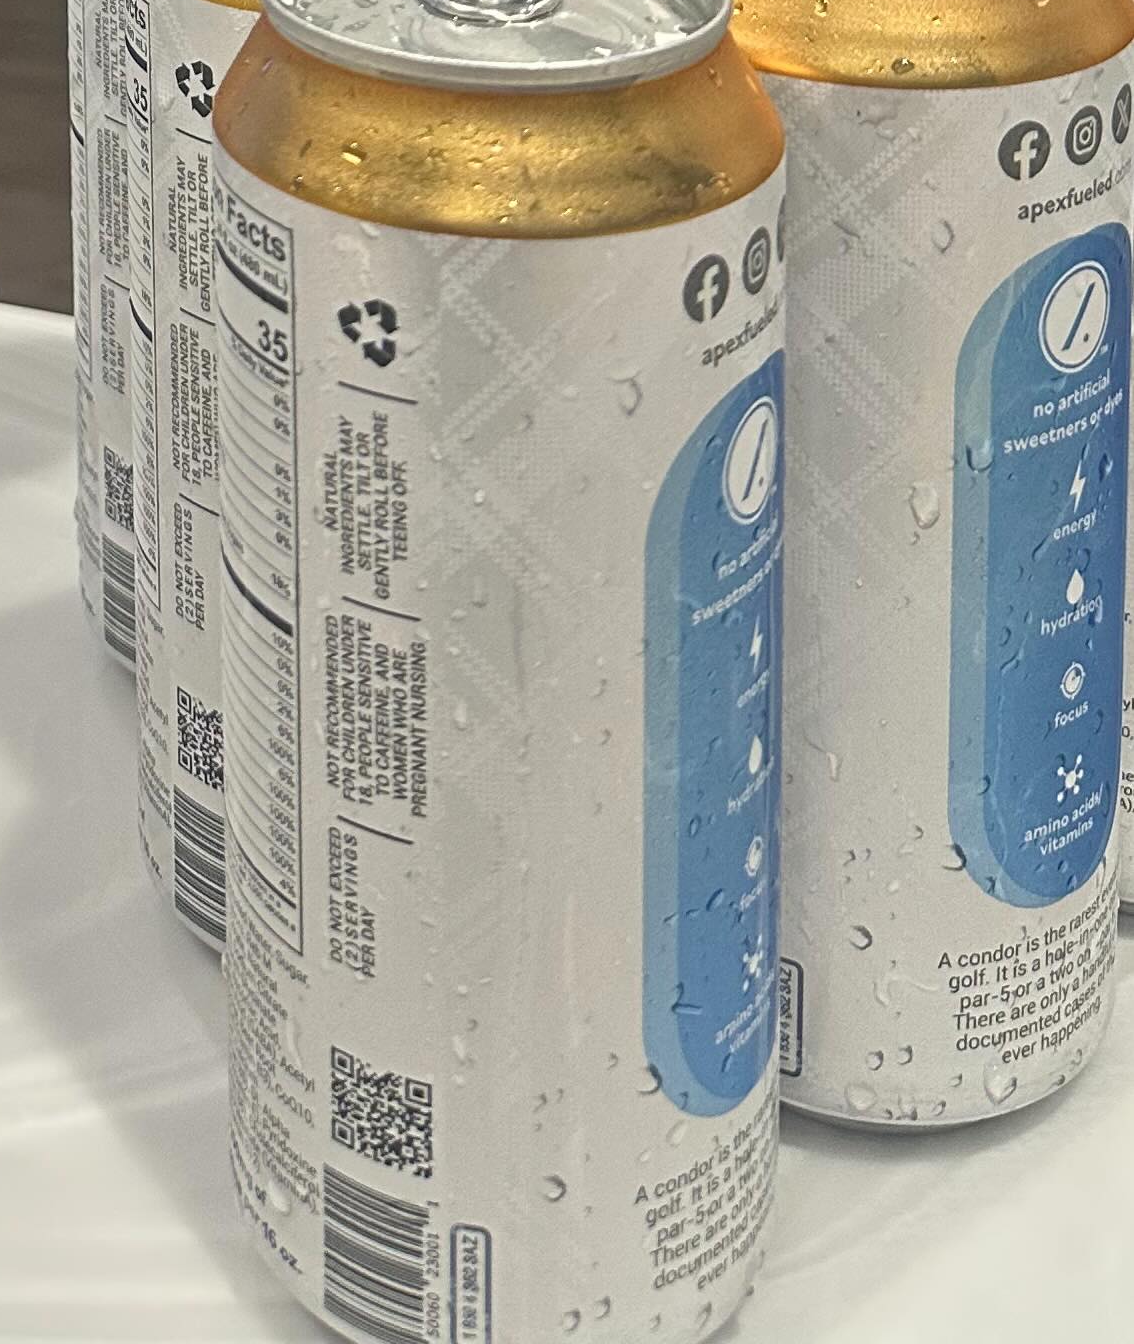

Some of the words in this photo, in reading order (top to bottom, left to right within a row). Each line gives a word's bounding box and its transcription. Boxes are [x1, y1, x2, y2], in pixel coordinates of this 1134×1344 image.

[133, 77, 149, 113] 35
[176, 155, 187, 190] MAY
[187, 170, 198, 191] OR
[197, 152, 209, 210] BEFORE
[168, 185, 178, 254] NATURAL
[187, 197, 199, 229] TILT
[199, 217, 210, 255] ROLL
[226, 193, 287, 263] Facts
[179, 322, 189, 374] UNDER
[258, 319, 288, 363] 35
[190, 327, 200, 404] SENSITIVE
[180, 376, 191, 451] CHILDREN
[1033, 400, 1054, 418] no
[1058, 367, 1111, 411] artificial
[191, 405, 202, 464] PEOPLE
[339, 415, 353, 456] MAY
[355, 431, 370, 458] OR
[372, 409, 388, 480] BEFORE
[1003, 416, 1087, 453] sweetners
[1089, 407, 1103, 426] or
[324, 450, 339, 532] NATURAL
[356, 459, 371, 497] TILT
[174, 502, 183, 558] EXCEED
[340, 459, 355, 576] INGREDIENTS
[373, 485, 389, 531] ROLL
[391, 500, 408, 561] TEEING
[1053, 509, 1098, 541] energy
[356, 503, 372, 571] SETTLE
[194, 570, 205, 599] DAY
[373, 532, 390, 600] GENTLY
[718, 559, 738, 581] no
[195, 601, 206, 632] PER
[1041, 595, 1103, 637] hydration
[341, 614, 355, 674] UNDER
[357, 618, 372, 710] SENSITIVE
[374, 643, 390, 682] AND
[392, 647, 407, 685] ARE
[325, 614, 339, 749] RECOMMENDED
[410, 641, 427, 721] NURSING
[341, 676, 356, 764] CHILDREN
[392, 687, 408, 730] WHO
[1054, 700, 1089, 729] focus
[326, 750, 340, 788] NOT
[358, 711, 373, 779] PEOPLE
[392, 733, 408, 800] WOMEN
[342, 766, 356, 802] FOR
[375, 773, 390, 795] TO
[410, 723, 427, 818] PREGNANT
[1024, 815, 1069, 843] amino
[1071, 781, 1104, 822] acids/
[1040, 816, 1094, 856] vitamins
[328, 826, 343, 892] EXCEED
[329, 894, 343, 933] NOT
[360, 904, 378, 942] DAY
[937, 951, 953, 970] A
[957, 942, 1022, 968] condor
[1026, 935, 1040, 954] is
[1044, 924, 1067, 947] the
[1069, 896, 1101, 933] rarest
[329, 937, 343, 964] DO
[360, 943, 377, 979] PER
[1016, 980, 1033, 999] or
[1036, 976, 1046, 992] a
[1050, 959, 1075, 985] two
[1076, 947, 1092, 969] on
[948, 968, 990, 995] golf.
[996, 966, 1008, 983] It
[1012, 957, 1027, 979] is
[1031, 958, 1041, 973] a
[953, 1007, 1007, 1032] There
[1010, 1000, 1037, 1022] are
[1040, 983, 1071, 1011] only
[1071, 975, 1080, 992] a
[956, 1004, 1062, 1053] documented
[1064, 982, 1097, 1019] cases
[1002, 1041, 1039, 1065] ever
[634, 1183, 649, 1205] A
[653, 1154, 715, 1198] condor
[718, 1143, 731, 1163] is
[732, 1122, 752, 1152] the
[426, 1231, 440, 1278] 23001
[650, 1232, 701, 1268] There
[705, 1212, 728, 1242] are
[653, 1211, 749, 1291] documented
[697, 1256, 728, 1291] ever
[426, 1291, 440, 1339] 50060
